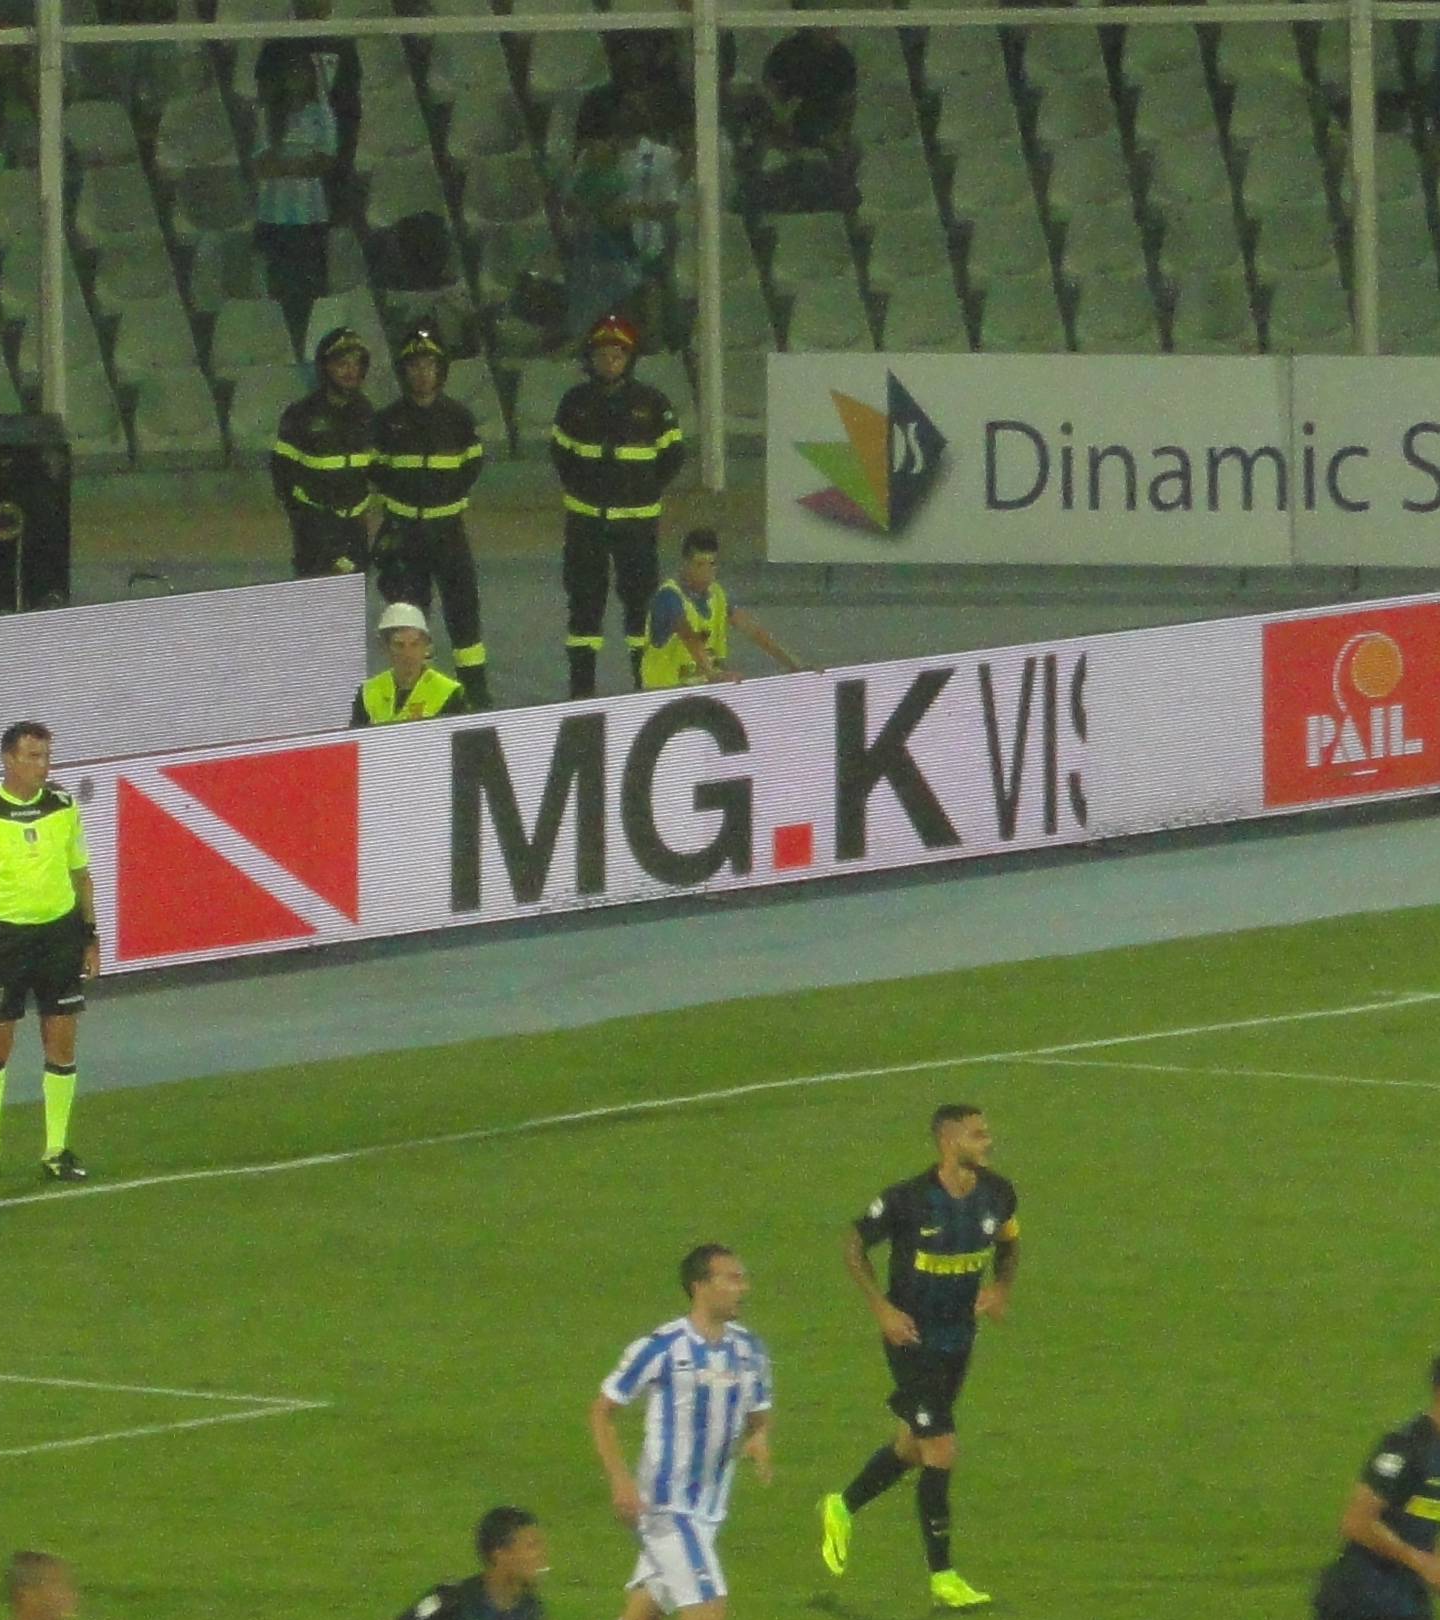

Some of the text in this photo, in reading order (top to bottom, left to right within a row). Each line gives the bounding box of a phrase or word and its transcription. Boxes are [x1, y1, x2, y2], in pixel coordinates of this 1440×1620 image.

[984, 419, 1371, 514] Dinamic
[1306, 703, 1424, 768] PAIL
[450, 667, 962, 916] MG.K
